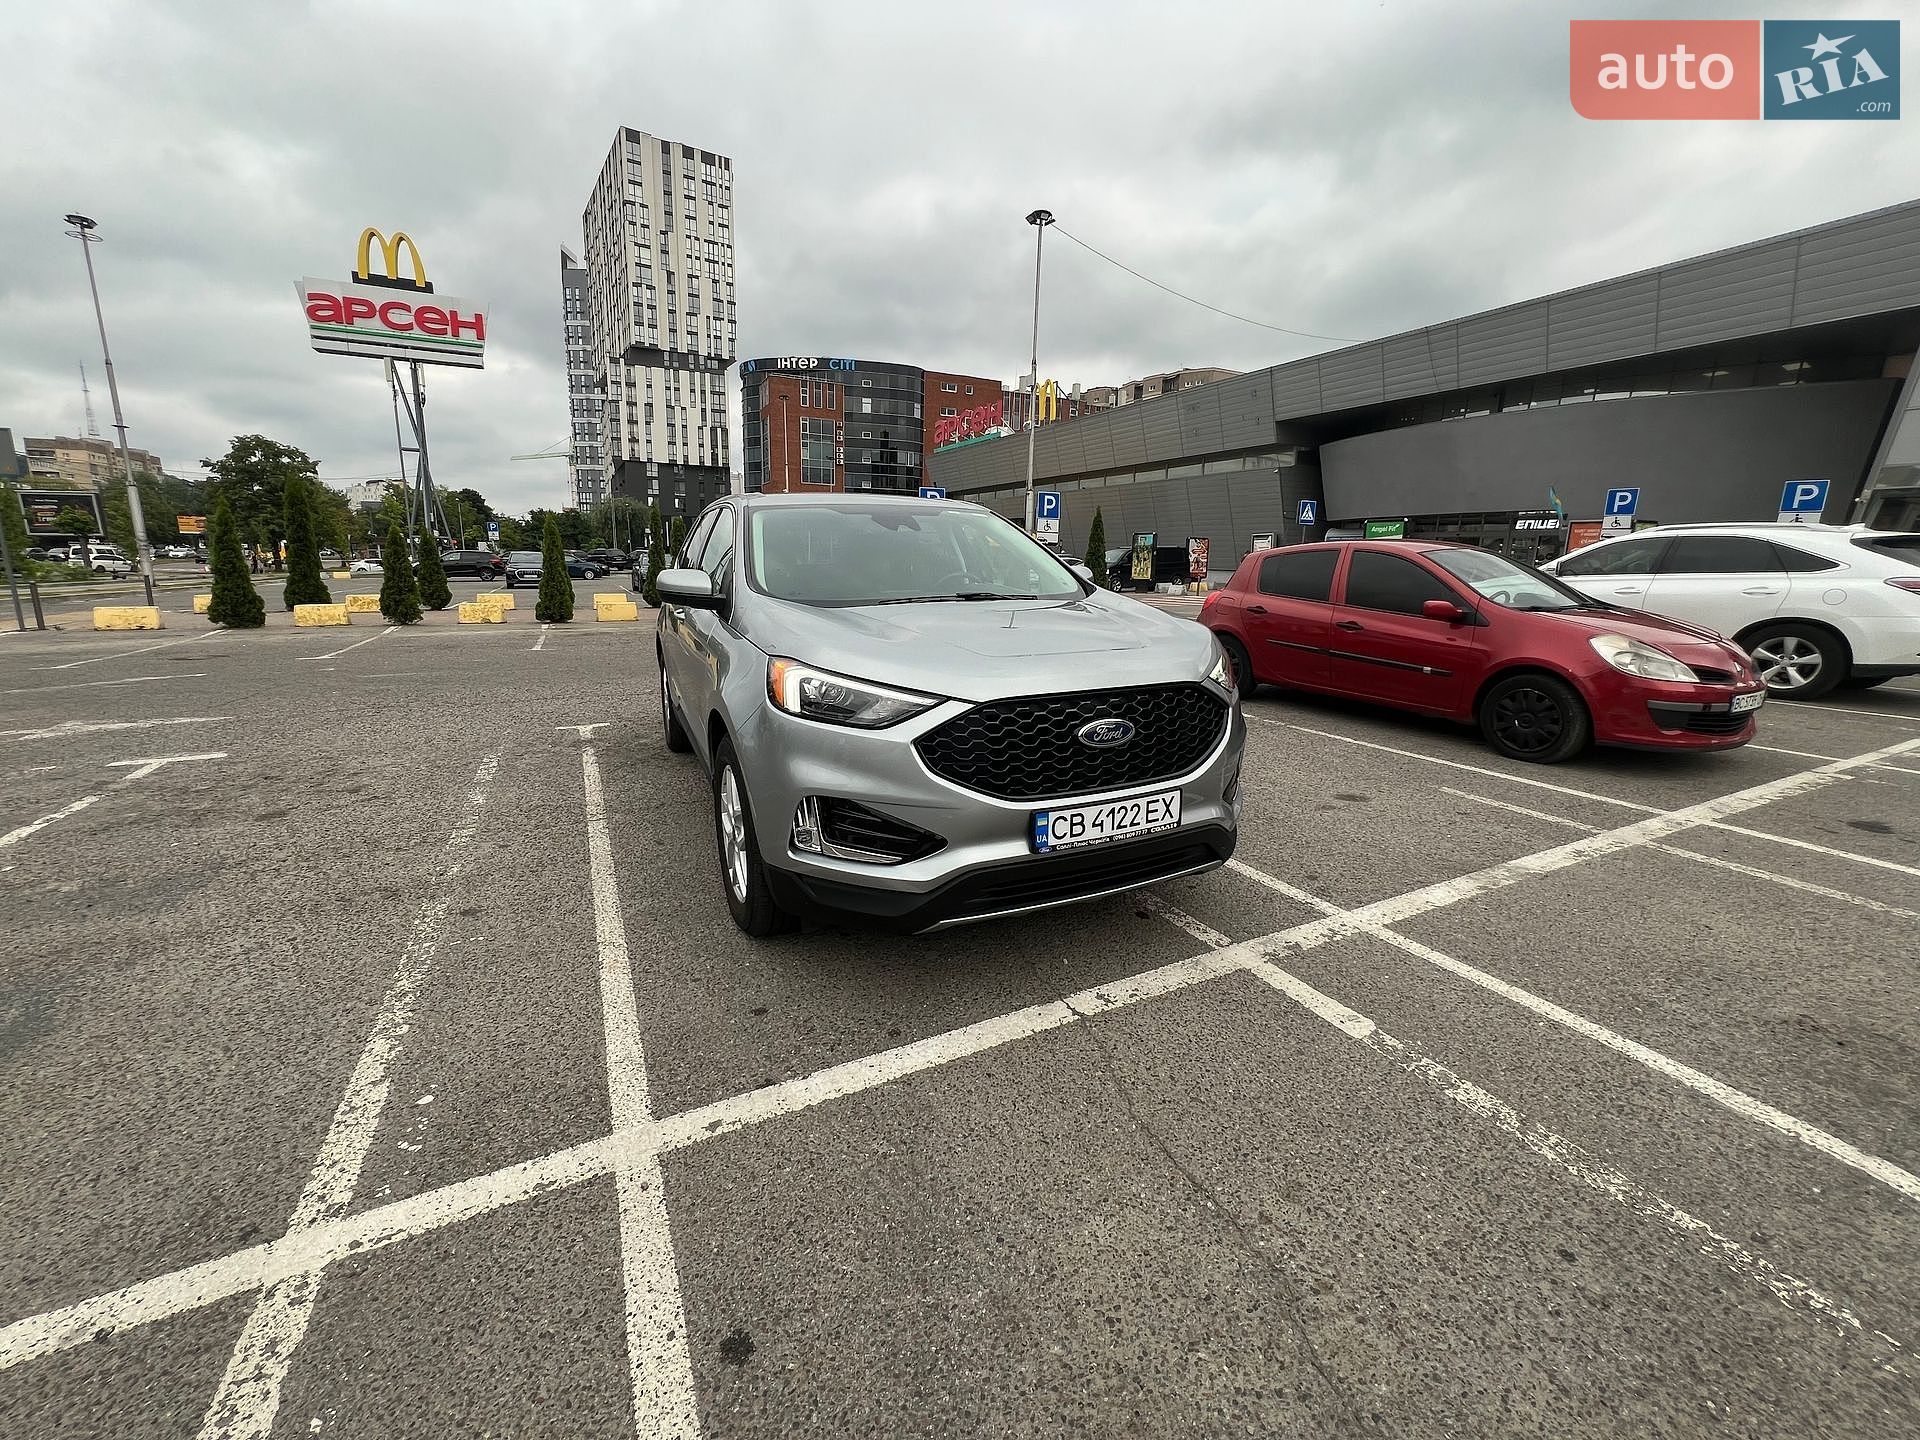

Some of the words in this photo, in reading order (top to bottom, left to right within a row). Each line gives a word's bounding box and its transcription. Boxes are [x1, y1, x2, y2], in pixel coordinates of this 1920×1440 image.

[1044, 495, 1056, 516] P
[1614, 491, 1632, 512] P
[1792, 484, 1819, 509] P
[1093, 724, 1124, 741] Ford
[1051, 812, 1086, 840] CB
[1092, 803, 1141, 834] 4122
[1146, 795, 1175, 824] EX
[1036, 834, 1048, 843] UA
